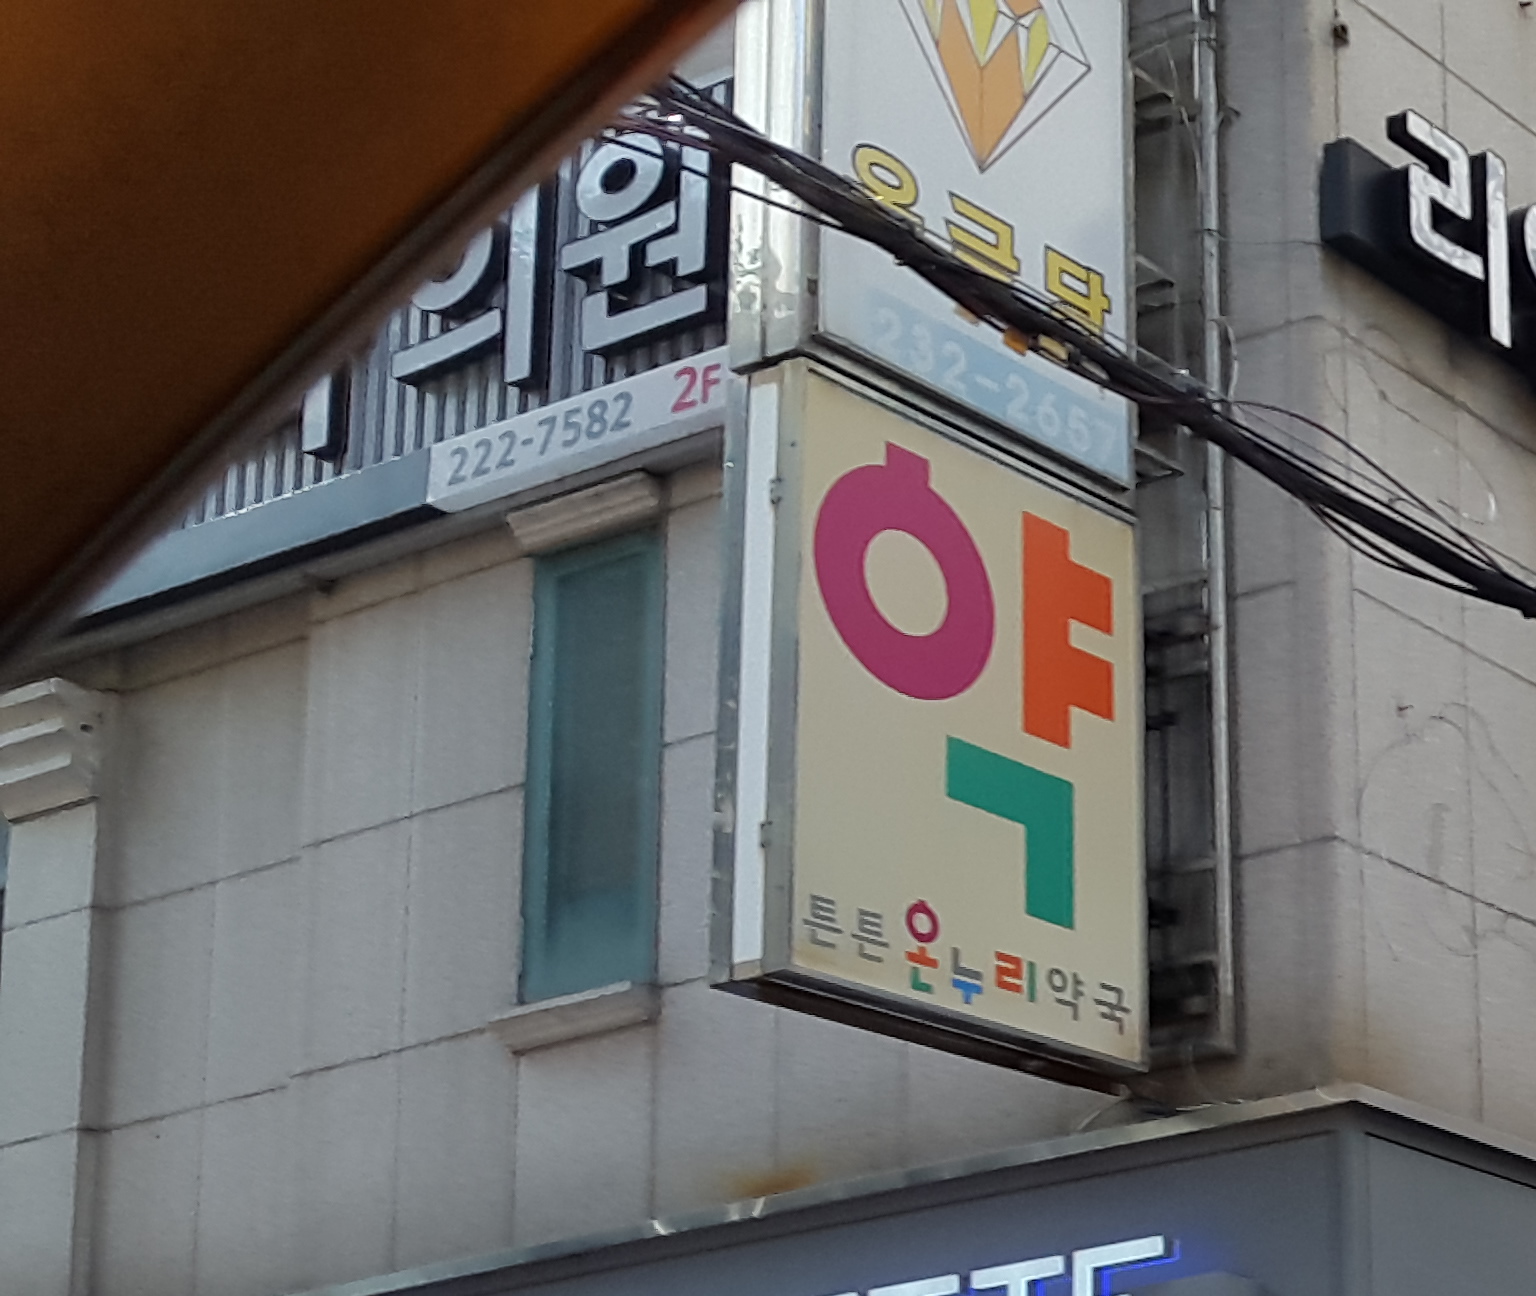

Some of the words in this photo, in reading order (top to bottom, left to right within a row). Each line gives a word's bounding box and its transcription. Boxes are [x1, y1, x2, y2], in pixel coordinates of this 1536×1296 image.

[446, 390, 635, 486] 222-7582
[669, 362, 723, 414] 2F
[813, 441, 1117, 931] 약
